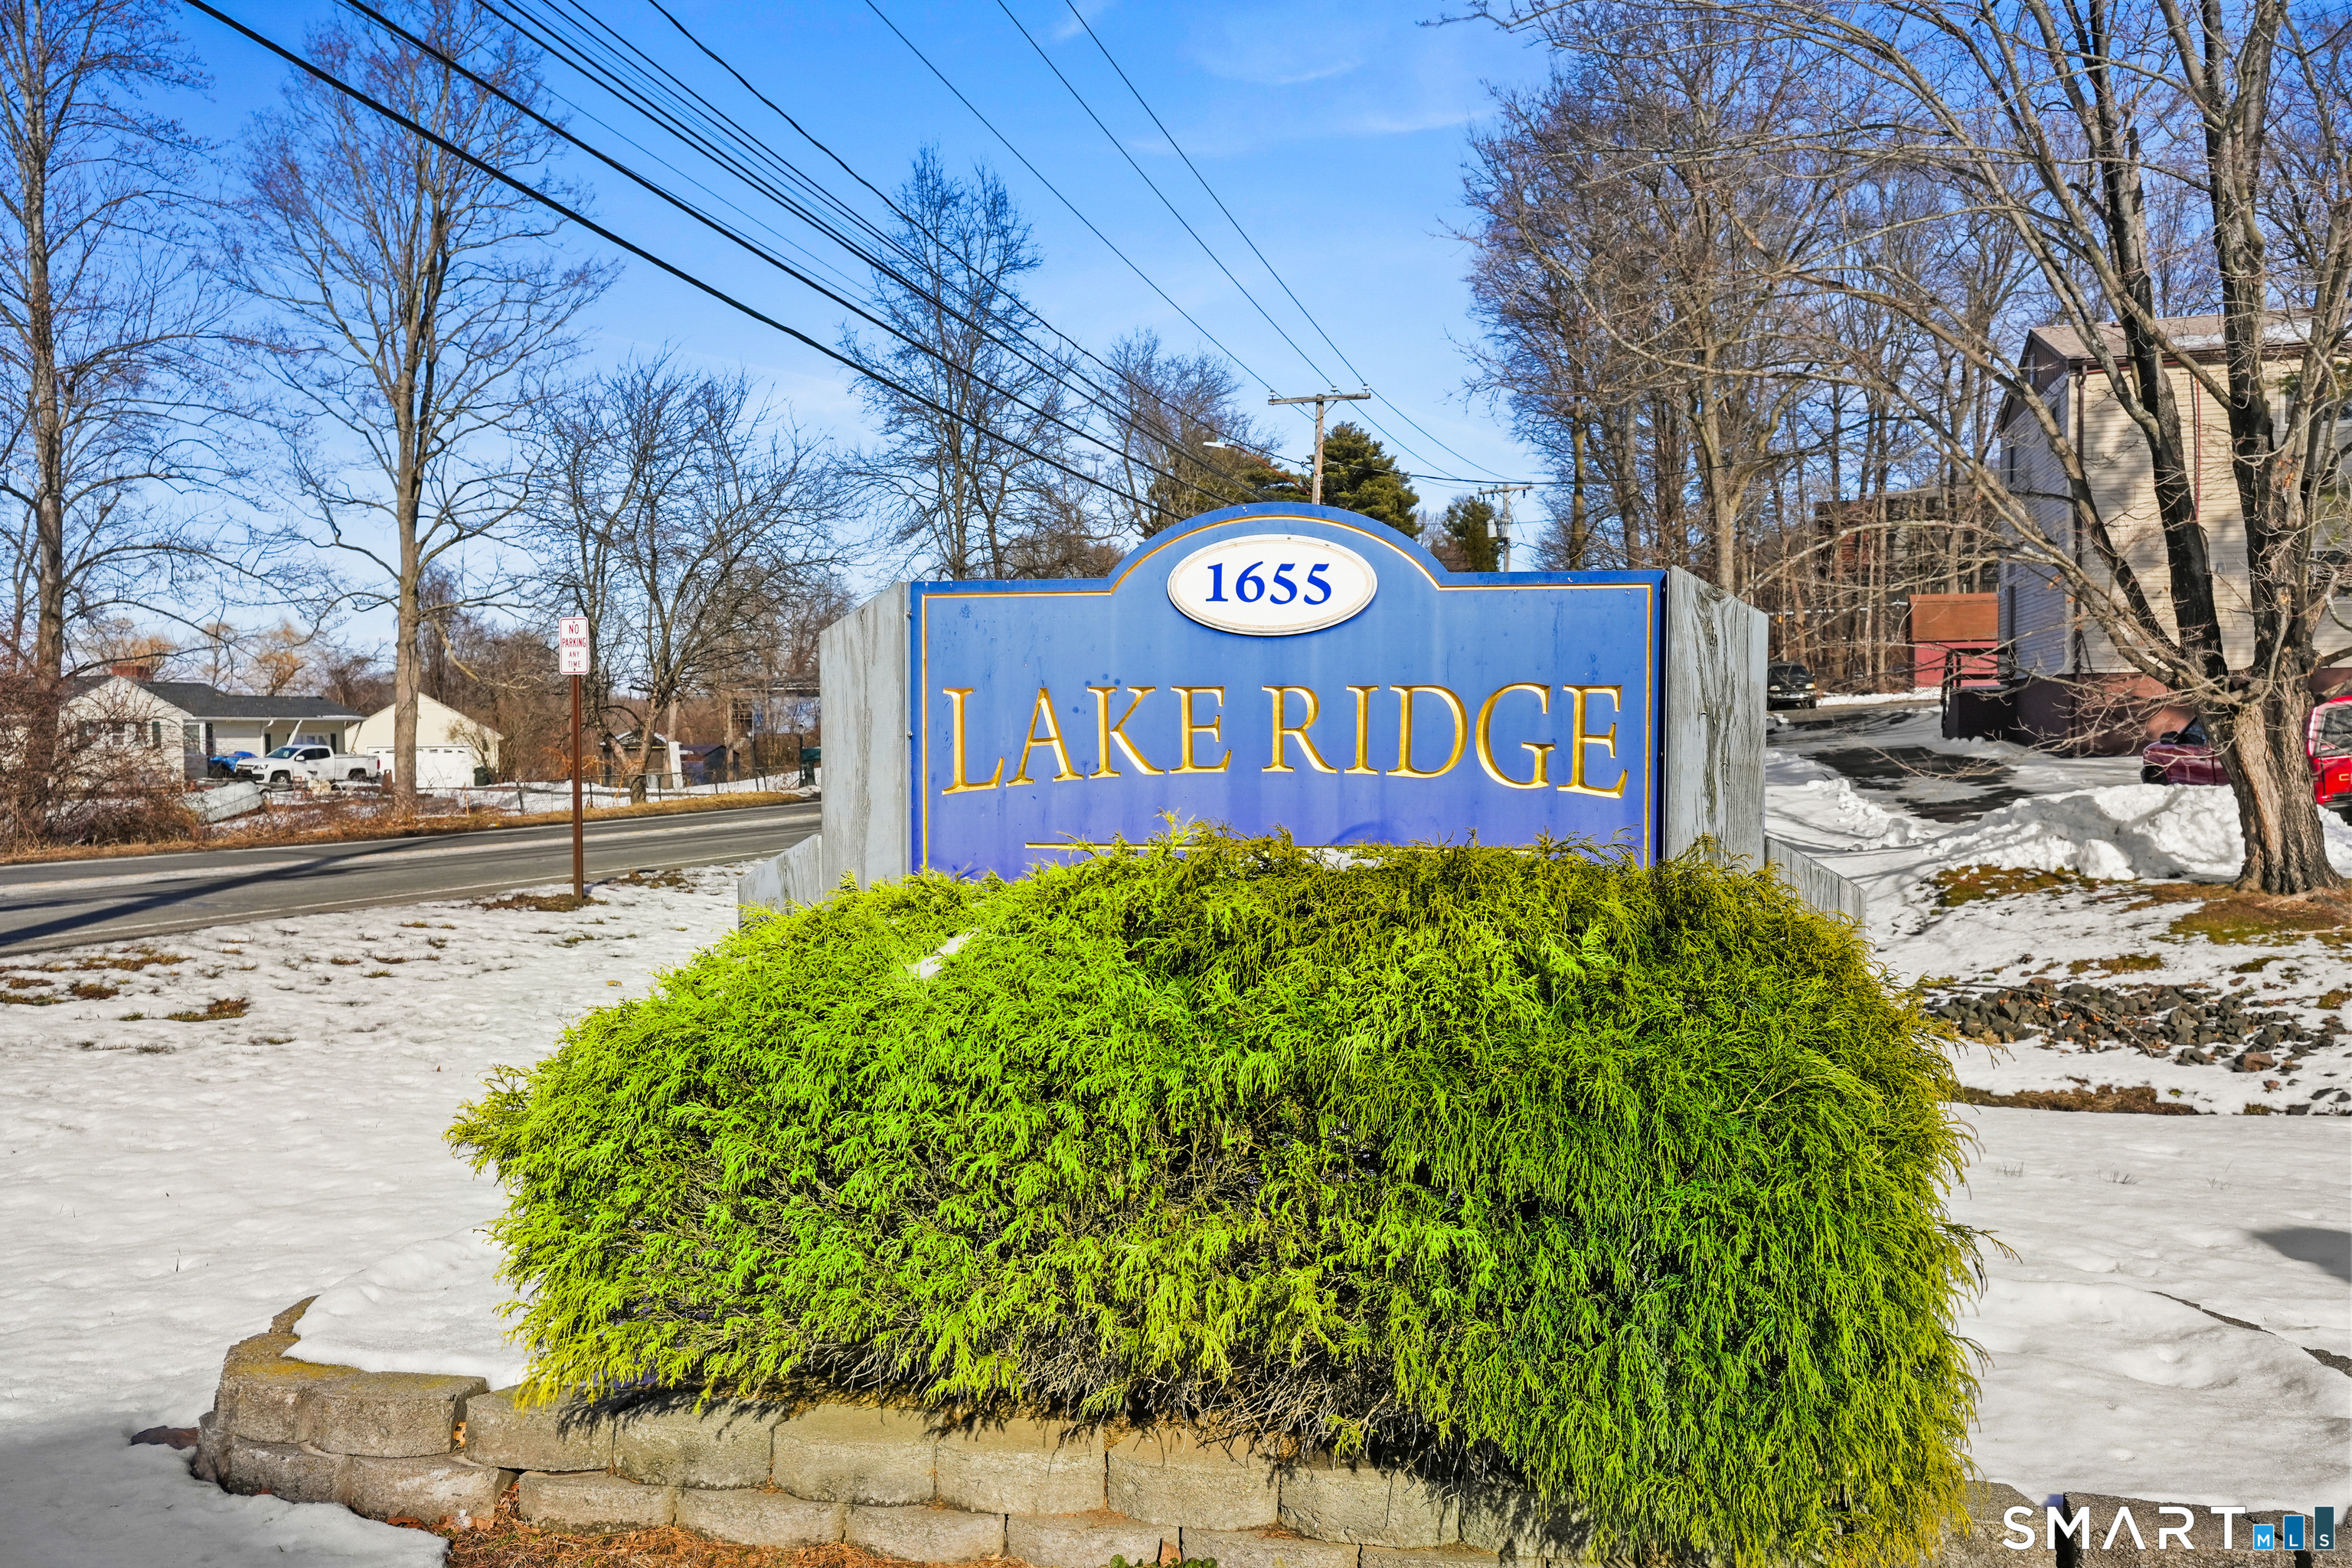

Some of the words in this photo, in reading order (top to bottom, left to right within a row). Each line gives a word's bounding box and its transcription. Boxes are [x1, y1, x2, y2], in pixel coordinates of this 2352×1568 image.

[1207, 561, 1331, 605] 1655
[562, 637, 586, 648] PARKING
[569, 624, 580, 634] NO
[942, 686, 1231, 795] LAKE
[1262, 682, 1628, 799] RIDGE
